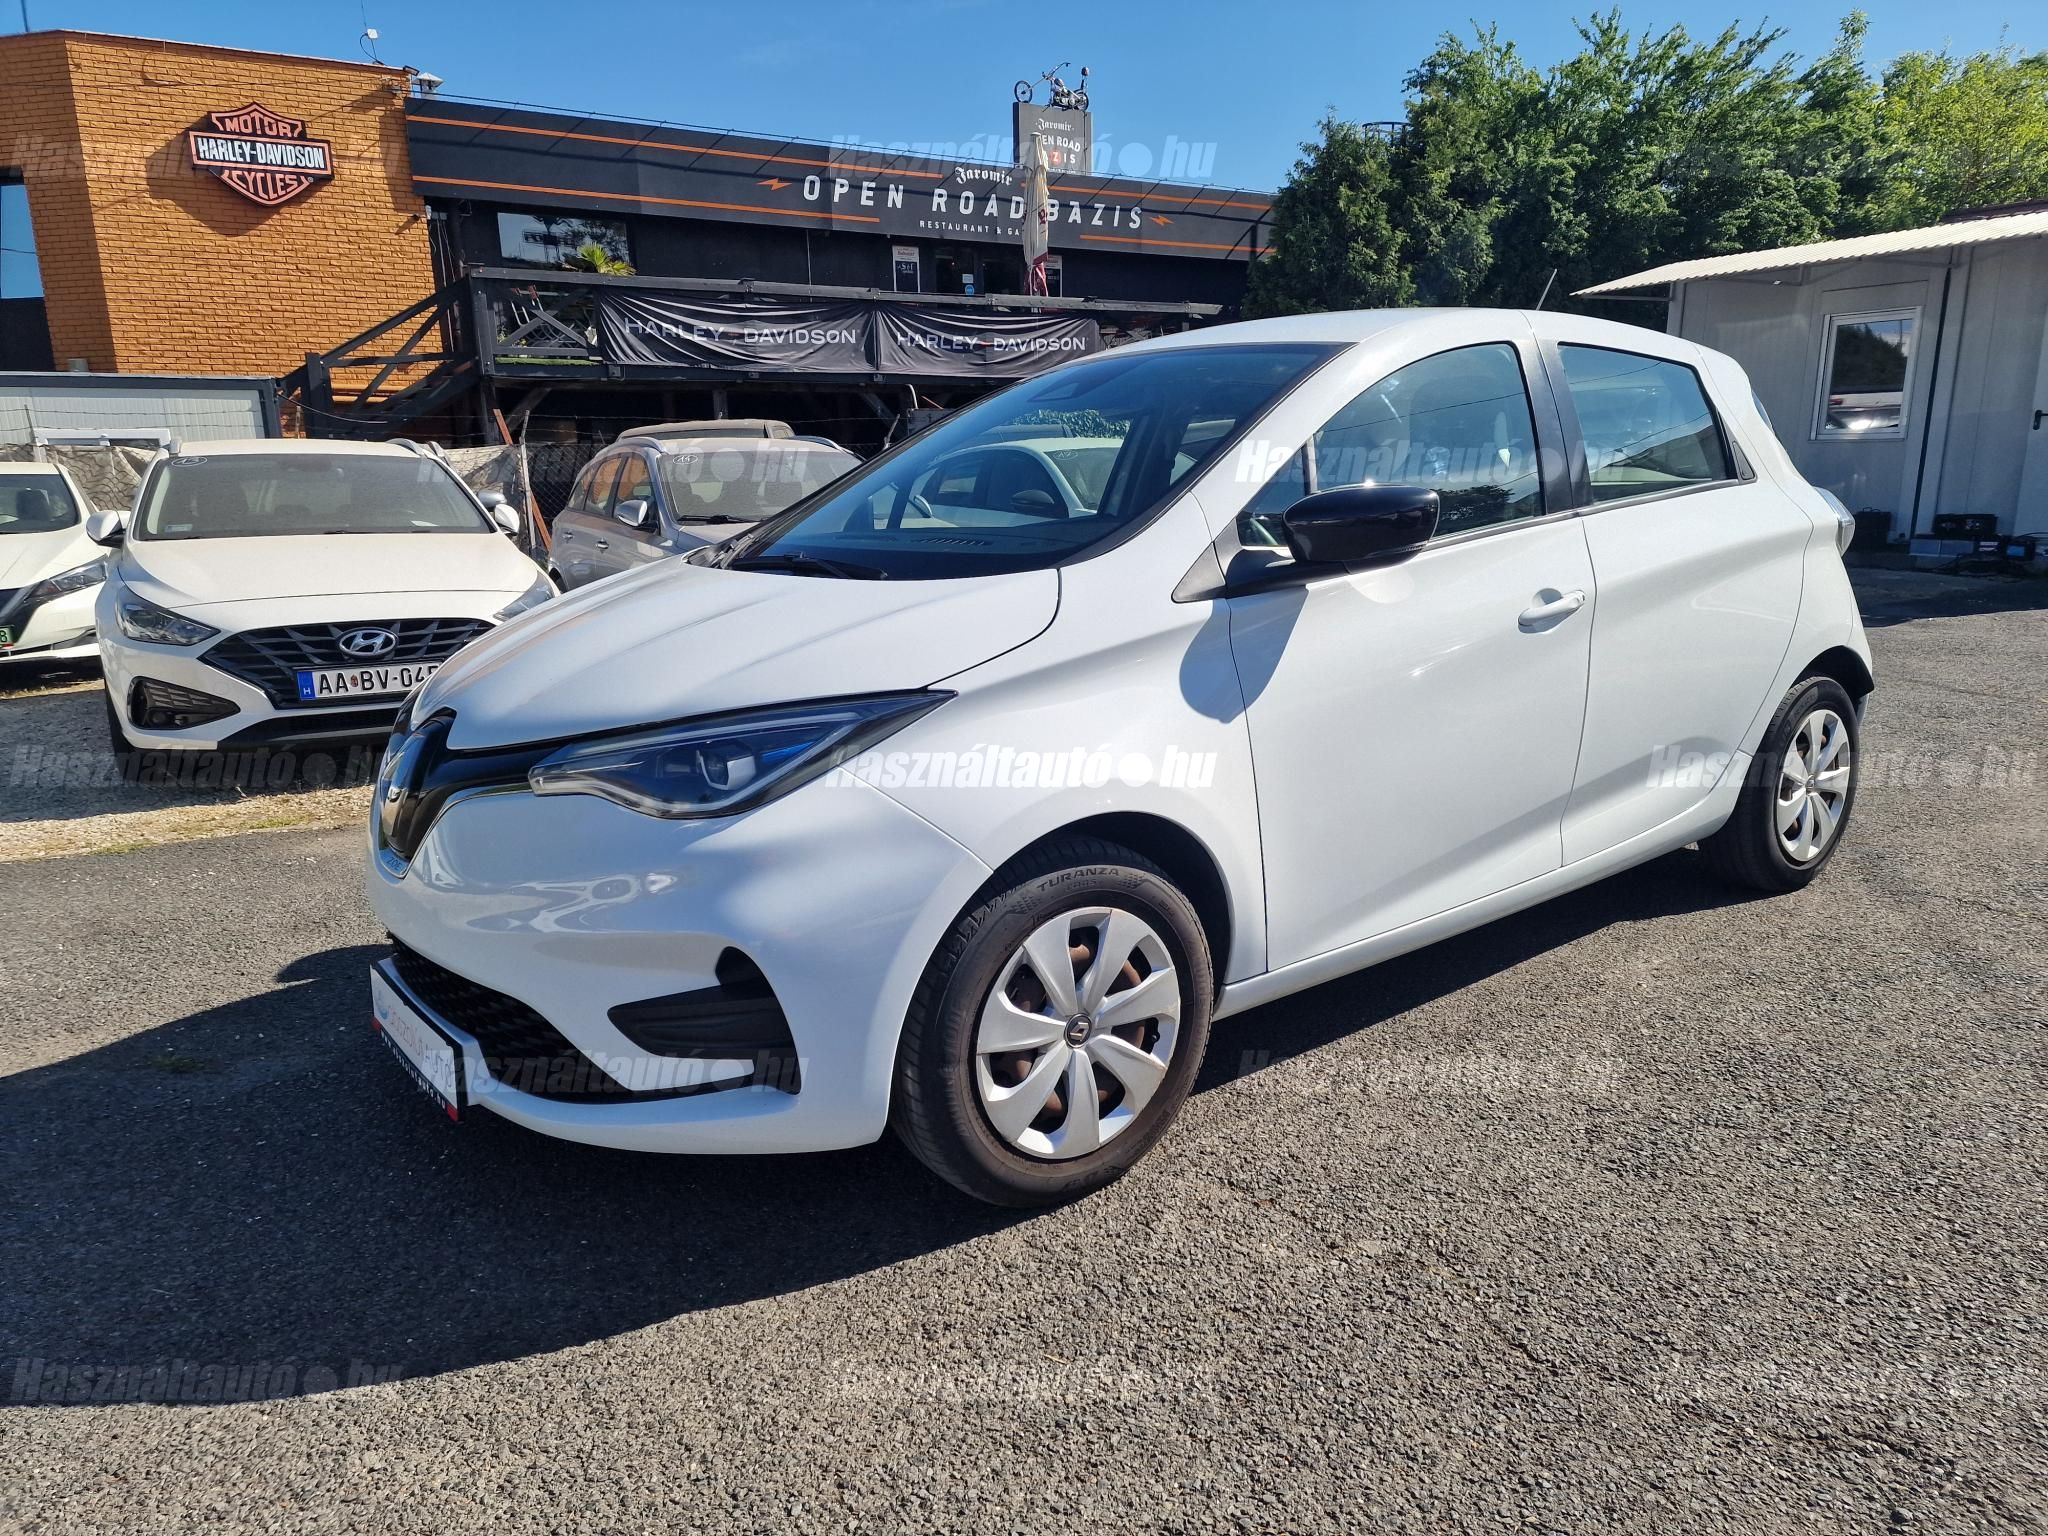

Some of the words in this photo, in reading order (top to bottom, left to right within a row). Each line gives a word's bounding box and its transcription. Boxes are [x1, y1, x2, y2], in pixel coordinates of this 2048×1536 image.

[224, 111, 292, 138] MOTOR
[1038, 118, 1073, 131] Jaromir
[196, 137, 325, 169] HARLEY-DAVIDSON
[1057, 137, 1081, 152] ROAD
[231, 170, 298, 200] CYCLES
[954, 166, 1013, 187] Jaromir
[803, 175, 904, 209] OPEN
[931, 188, 1024, 219] ROAD
[919, 220, 990, 233] RESTAURANT
[996, 226, 1002, 235] &
[319, 672, 349, 694] AA
[1037, 866, 1120, 892] TURANZA
